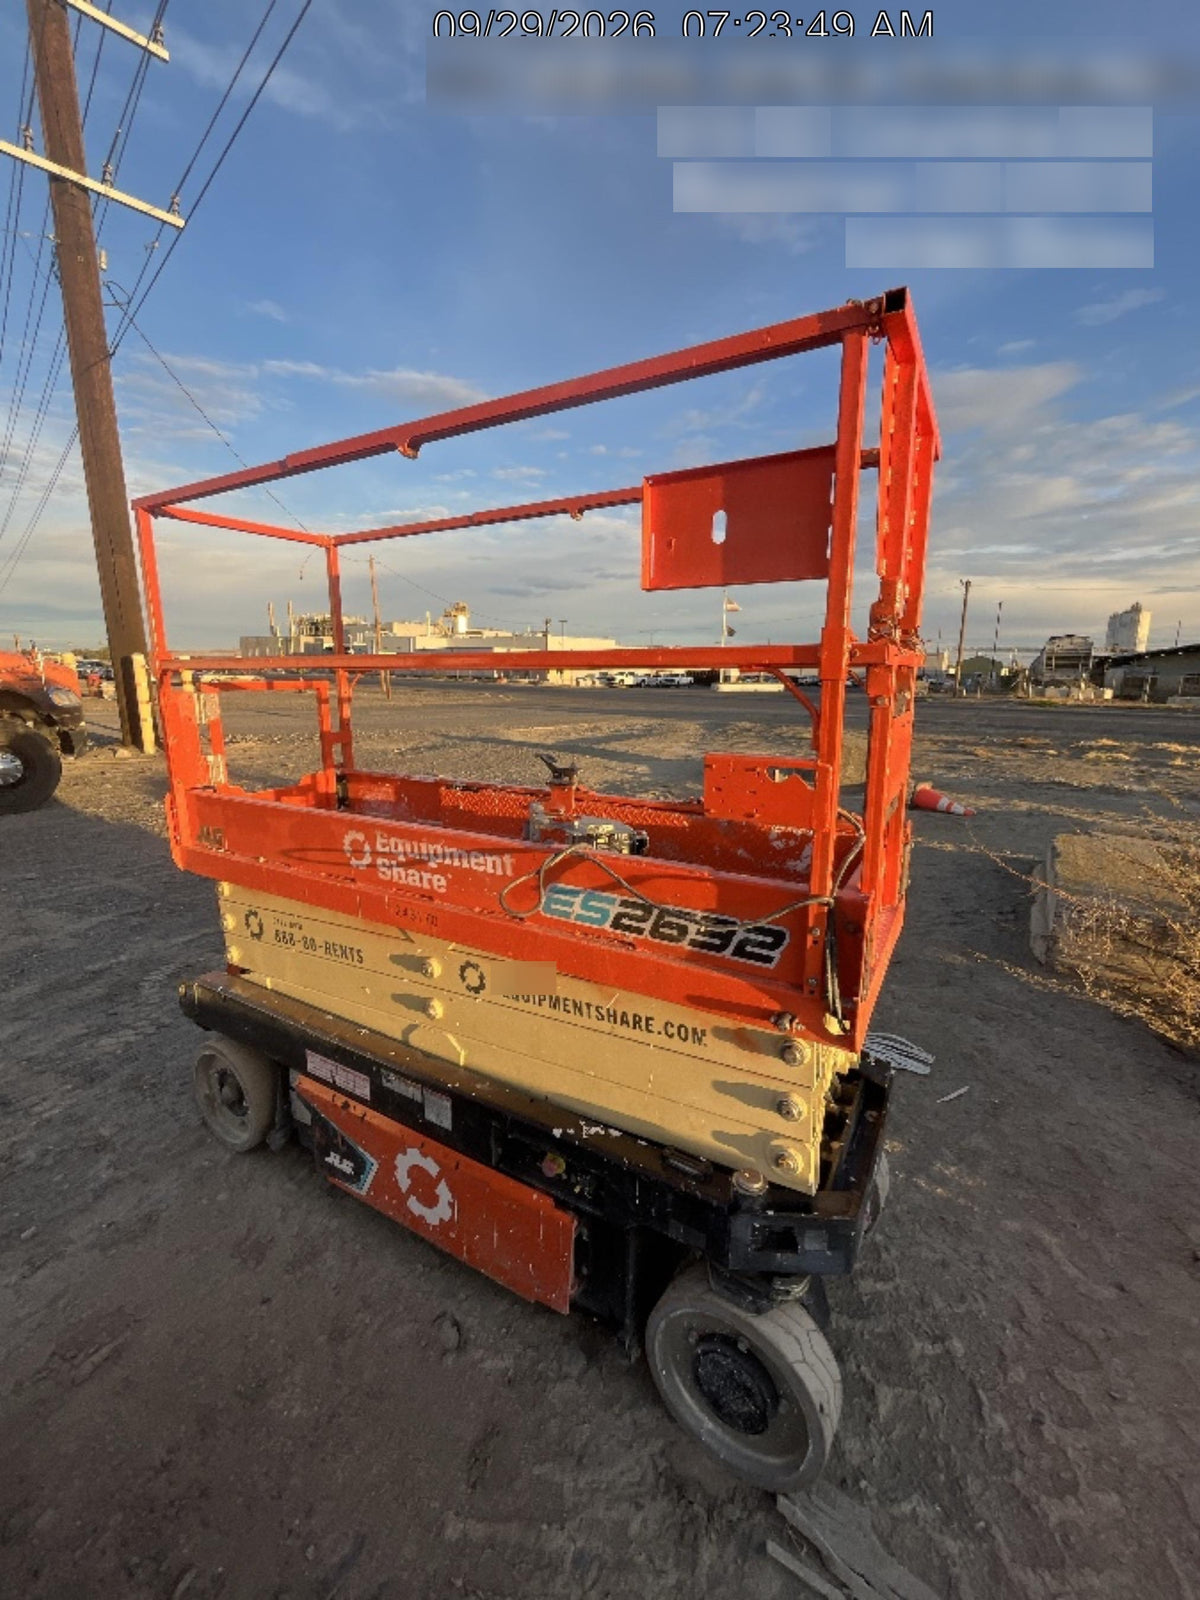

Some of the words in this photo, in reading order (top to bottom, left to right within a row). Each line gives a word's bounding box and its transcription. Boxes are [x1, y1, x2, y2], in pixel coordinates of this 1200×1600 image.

[376, 831, 516, 876] Equipment
[376, 857, 447, 893] Share
[540, 883, 790, 969] ES2632
[503, 993, 708, 1046] UIPMENTSHARE.COM
